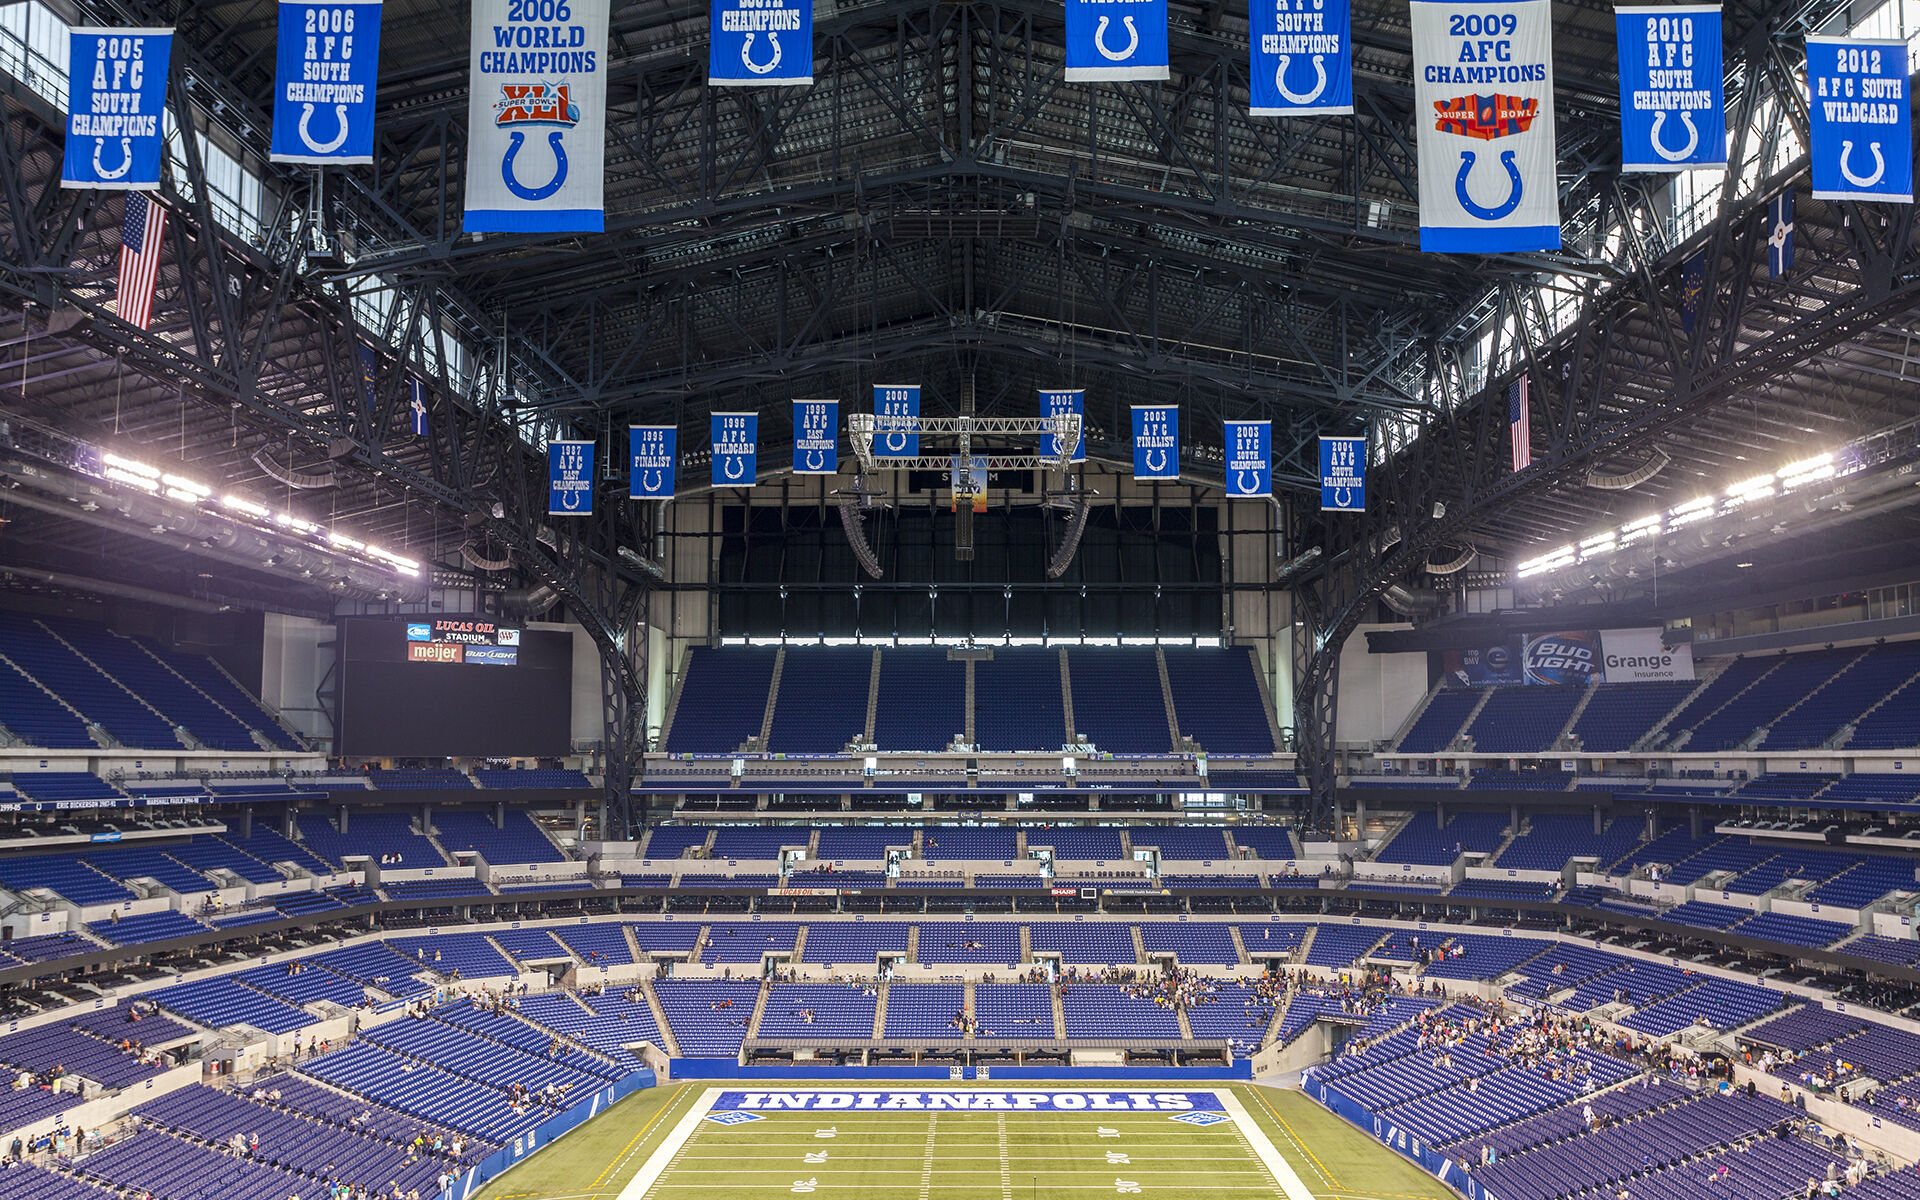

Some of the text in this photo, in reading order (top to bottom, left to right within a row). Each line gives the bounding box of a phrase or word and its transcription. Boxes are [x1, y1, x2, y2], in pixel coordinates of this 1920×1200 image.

[508, 0, 570, 22] 2006
[305, 8, 354, 34] 2006
[722, 9, 800, 32] CHAMPIONS
[1276, 13, 1324, 32] SOUTH
[1449, 14, 1517, 36] 2009
[1646, 17, 1693, 42] 2010
[493, 26, 585, 48] WORLD
[97, 38, 143, 60] 2005
[304, 36, 352, 60] AFC
[1262, 34, 1339, 54] CHAMPIONS
[1458, 40, 1511, 62] AFC
[1648, 43, 1693, 68] AFC
[480, 52, 596, 74] CHAMPIONS
[1837, 49, 1881, 74] 2012
[93, 61, 143, 89] AFC
[303, 62, 350, 81] SOUTH
[1424, 64, 1546, 84] CHAMPIONS
[1649, 70, 1693, 89] SOUTH
[286, 82, 364, 104] CHAMPIONS
[1818, 77, 1902, 100] AFC SOUTH
[92, 92, 140, 114] SOUTH
[498, 98, 553, 108] SUPER BOWL
[1633, 90, 1712, 110] CHAMPIONS
[1500, 110, 1533, 118] BOWL
[1823, 102, 1898, 124] WILDCARD
[72, 114, 157, 137] CHAMPIONS
[886, 390, 908, 401] 2000
[806, 405, 826, 415] 1999
[884, 402, 909, 415] AFC
[724, 418, 745, 429] 1996
[803, 415, 828, 429] AFC
[1144, 412, 1166, 422] 2003
[643, 431, 663, 442] 1995
[722, 430, 746, 443] AFC
[806, 429, 823, 440] EAST
[1143, 424, 1167, 436] AFC
[796, 439, 834, 450] CHAMPIONS
[1136, 436, 1174, 448] FINALIST
[1237, 438, 1259, 450] AFC
[1332, 442, 1353, 452] 2004
[561, 446, 582, 456] 1987
[641, 443, 664, 456] AFC
[713, 443, 755, 455] WILDCARD
[1237, 451, 1259, 460] SOUTH
[559, 456, 583, 470] AFC
[635, 456, 671, 468] FINALIST
[1231, 460, 1266, 470] CHAMPIONS
[1331, 452, 1355, 466] AFC
[563, 470, 579, 480] EAST
[1332, 466, 1353, 477] SOUTH
[553, 480, 590, 490] CHAMPIONS
[1324, 477, 1362, 488] CHAMPIONS
[436, 620, 473, 632] LUCAS
[476, 622, 495, 633] OIL
[446, 633, 485, 641] STADIUM
[414, 643, 457, 661] meijer
[489, 650, 517, 659] LIGHT
[1536, 643, 1592, 660] BUD
[1528, 656, 1595, 672] LIGHT
[1606, 654, 1672, 670] Grange
[1634, 670, 1673, 678] Insurance
[486, 757, 510, 765] hhgregg
[737, 1093, 1194, 1110] INDIANAPOLIS
[814, 1128, 837, 1138] 10
[1097, 1128, 1120, 1138] 10
[803, 1152, 826, 1163] 20
[1105, 1153, 1130, 1164] 20
[790, 1180, 817, 1192] 30
[1115, 1181, 1142, 1194] 30
